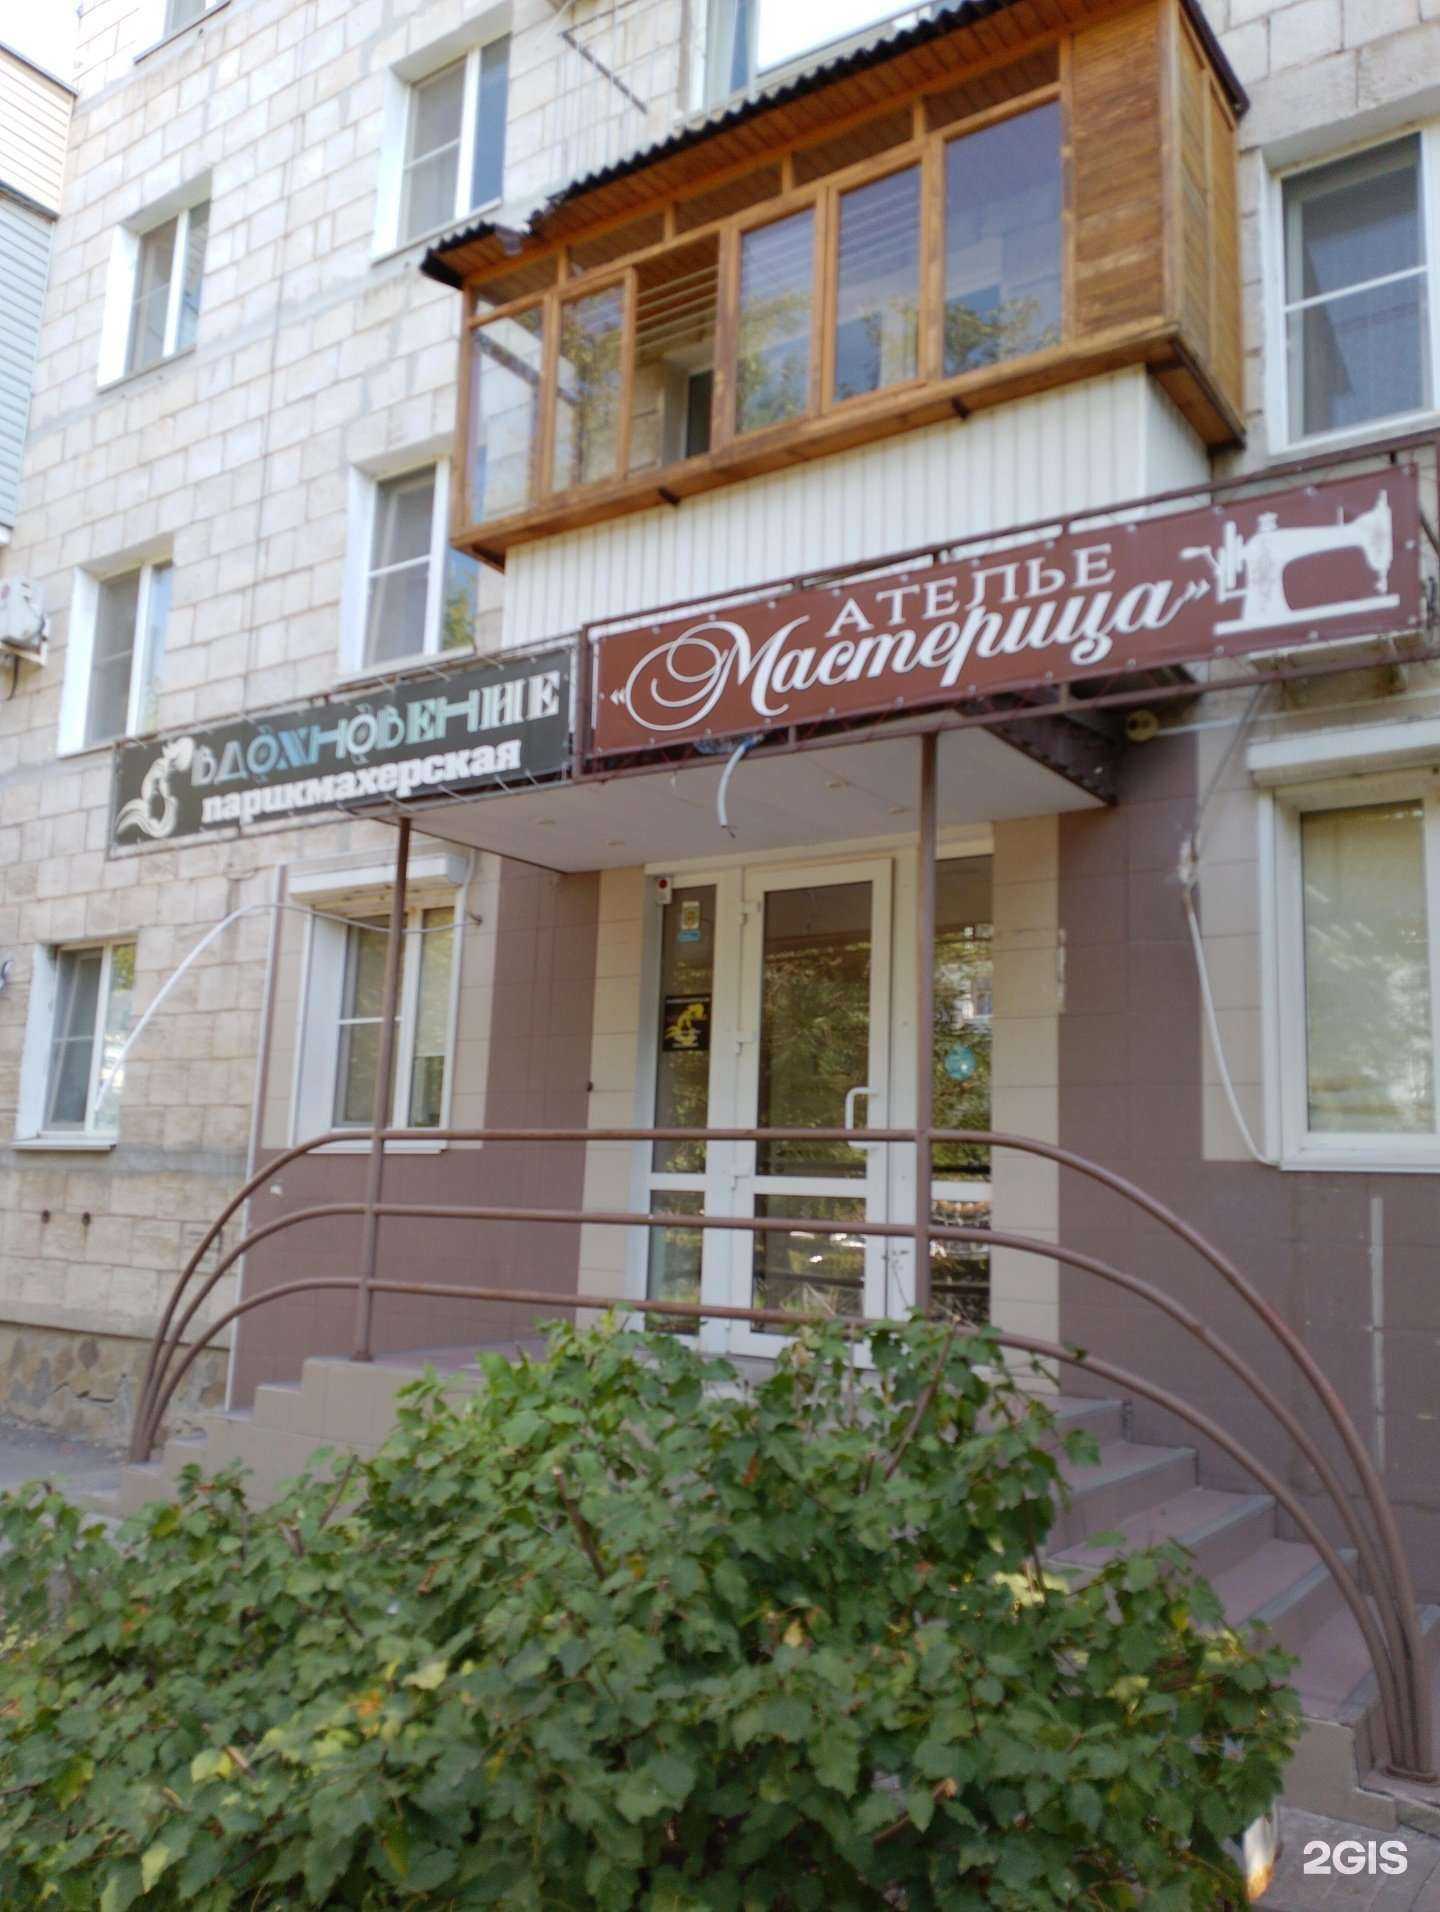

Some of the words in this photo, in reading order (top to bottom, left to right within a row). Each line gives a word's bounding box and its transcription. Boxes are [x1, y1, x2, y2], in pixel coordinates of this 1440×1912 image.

[825, 543, 1116, 638] АТЕЛЬЕ
[609, 578, 1211, 731] «Мастерица»
[191, 670, 561, 787] ВДОХНОВЕНИЕ
[201, 739, 522, 826] парикмахерская
